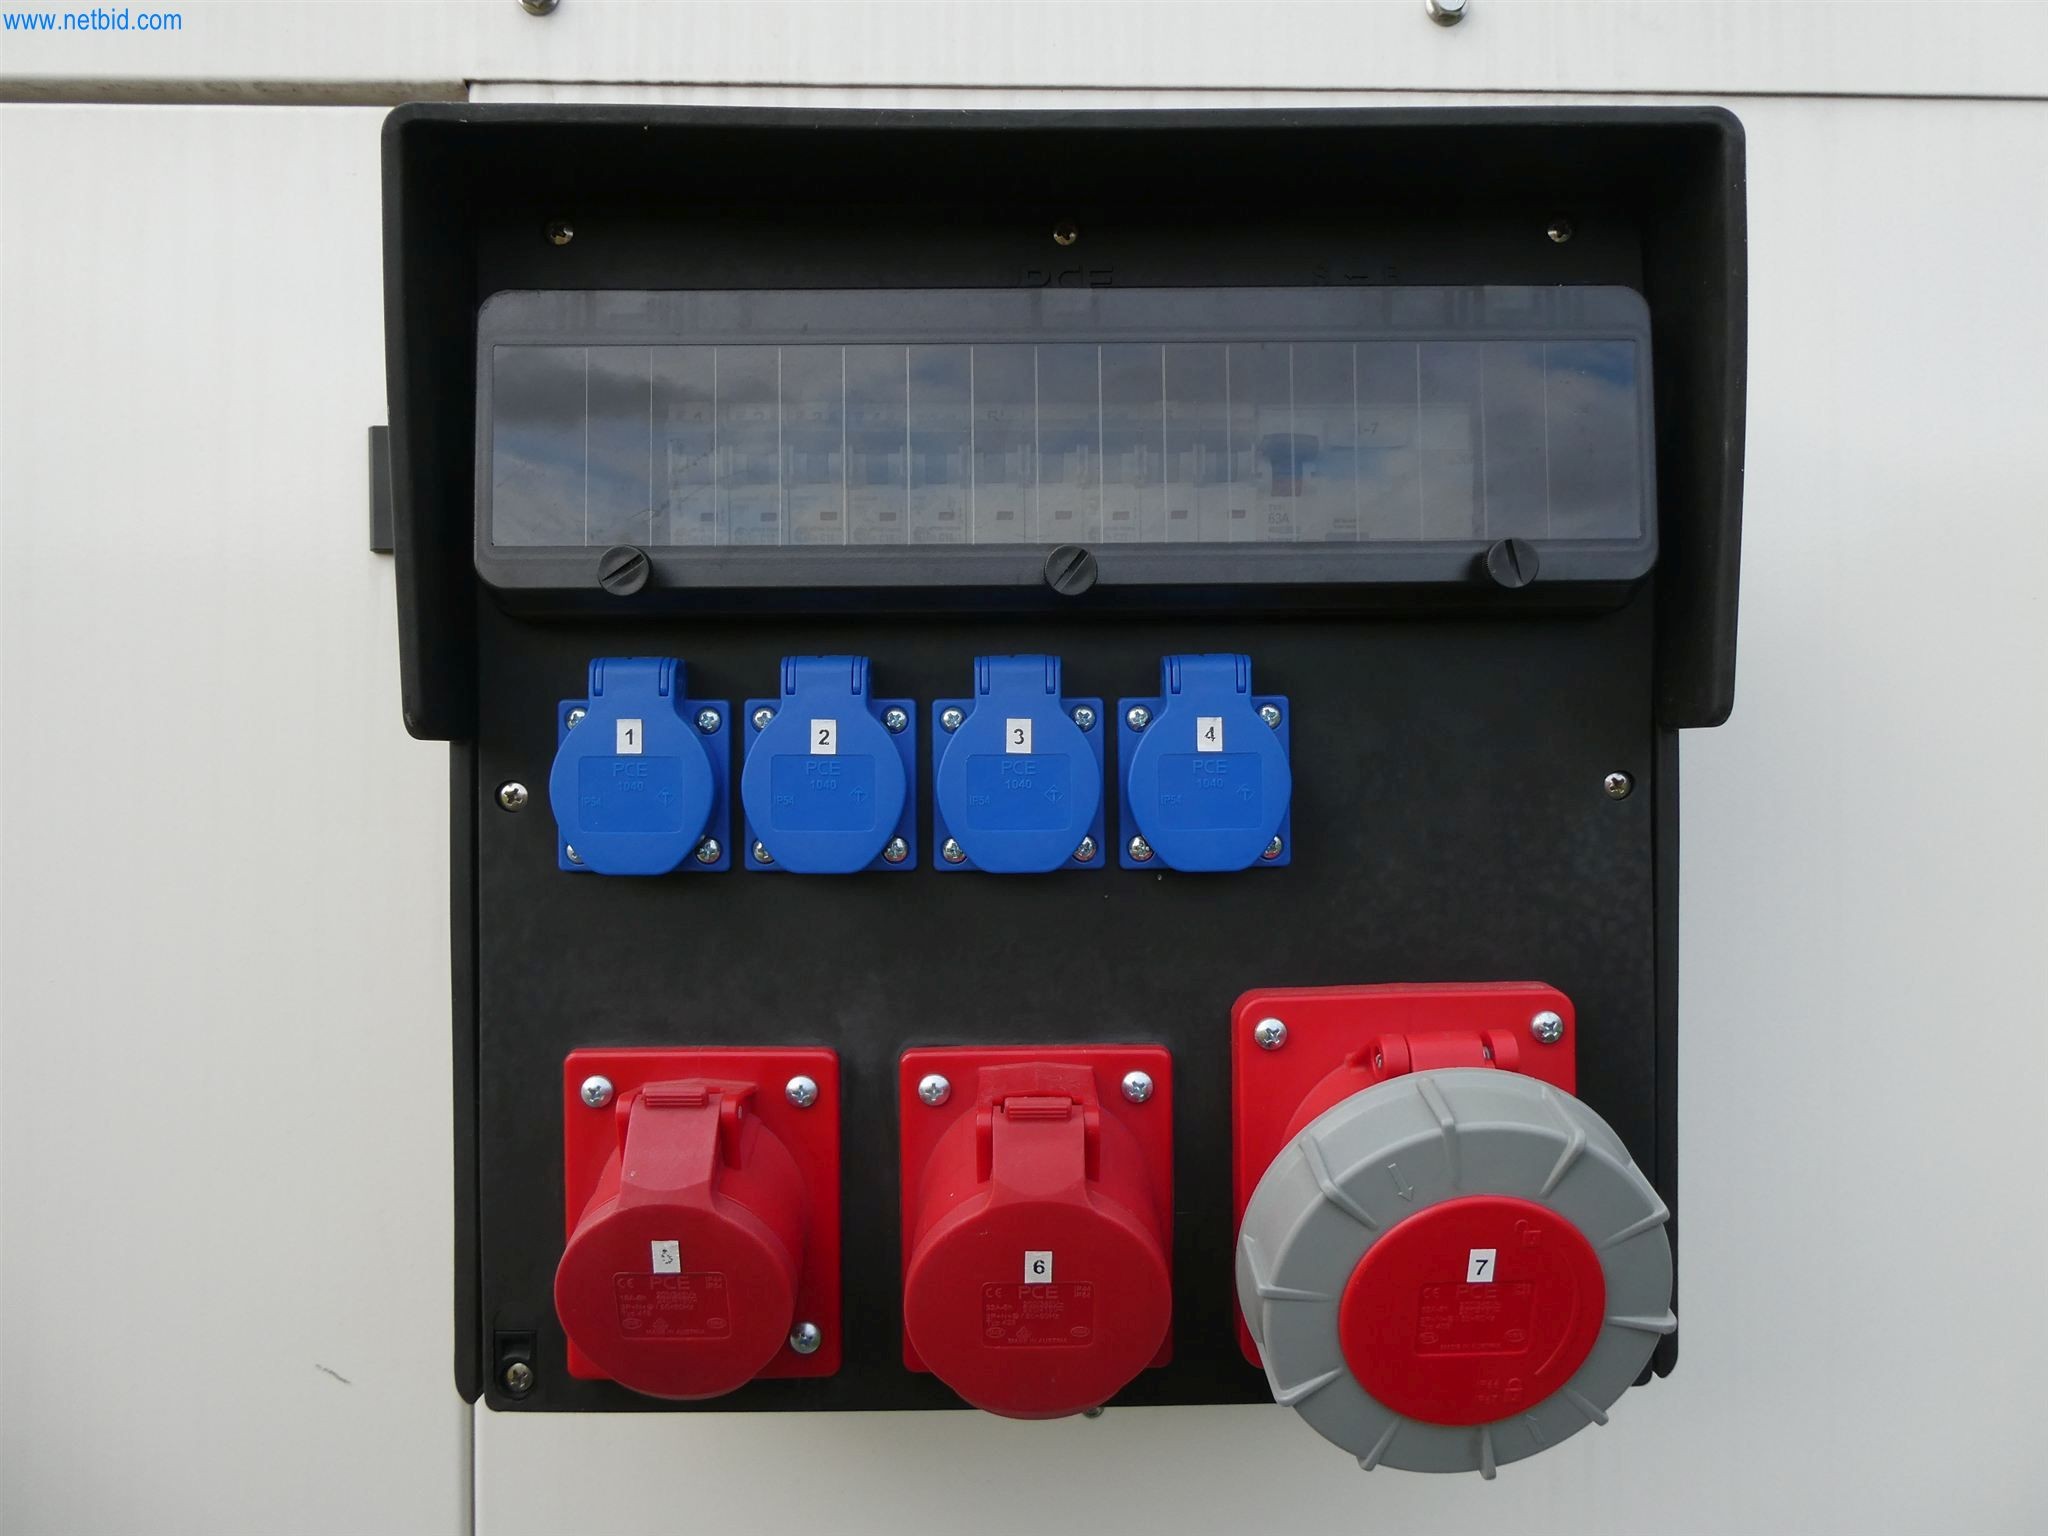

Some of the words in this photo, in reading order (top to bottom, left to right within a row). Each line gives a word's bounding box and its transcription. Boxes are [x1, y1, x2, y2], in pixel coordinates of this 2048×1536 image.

[625, 728, 634, 745] 1
[819, 729, 829, 745] 2
[1014, 728, 1025, 745] 3
[1204, 726, 1215, 742] 4
[612, 762, 648, 777] PCE
[806, 760, 841, 776] PCE
[1001, 760, 1037, 775] PCE
[1192, 759, 1227, 774] PCE
[810, 779, 837, 790] 1040
[1005, 779, 1032, 790] 1040
[1197, 778, 1224, 788] 1040
[1033, 1260, 1045, 1274] 6
[1475, 1260, 1489, 1275] 7
[650, 1276, 690, 1290] PCE
[1018, 1285, 1059, 1299] PCE
[1456, 1284, 1498, 1299] PCE
